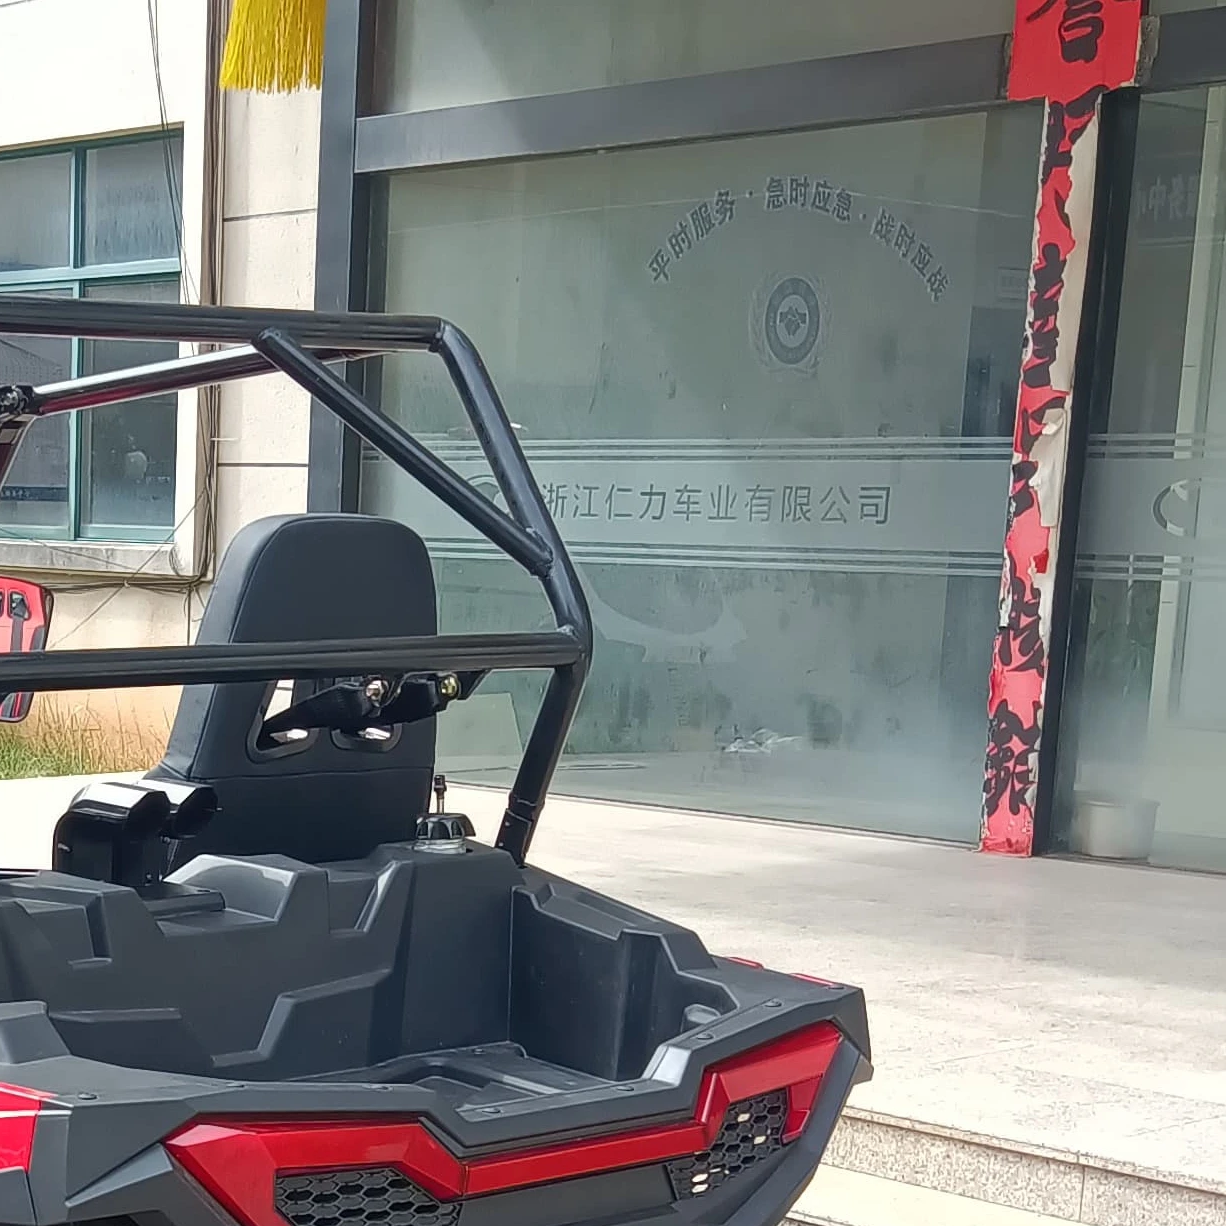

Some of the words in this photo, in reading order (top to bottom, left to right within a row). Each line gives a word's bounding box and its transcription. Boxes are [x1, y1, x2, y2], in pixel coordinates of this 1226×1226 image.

[542, 484, 891, 525] 浙江仁力车业有限公司
